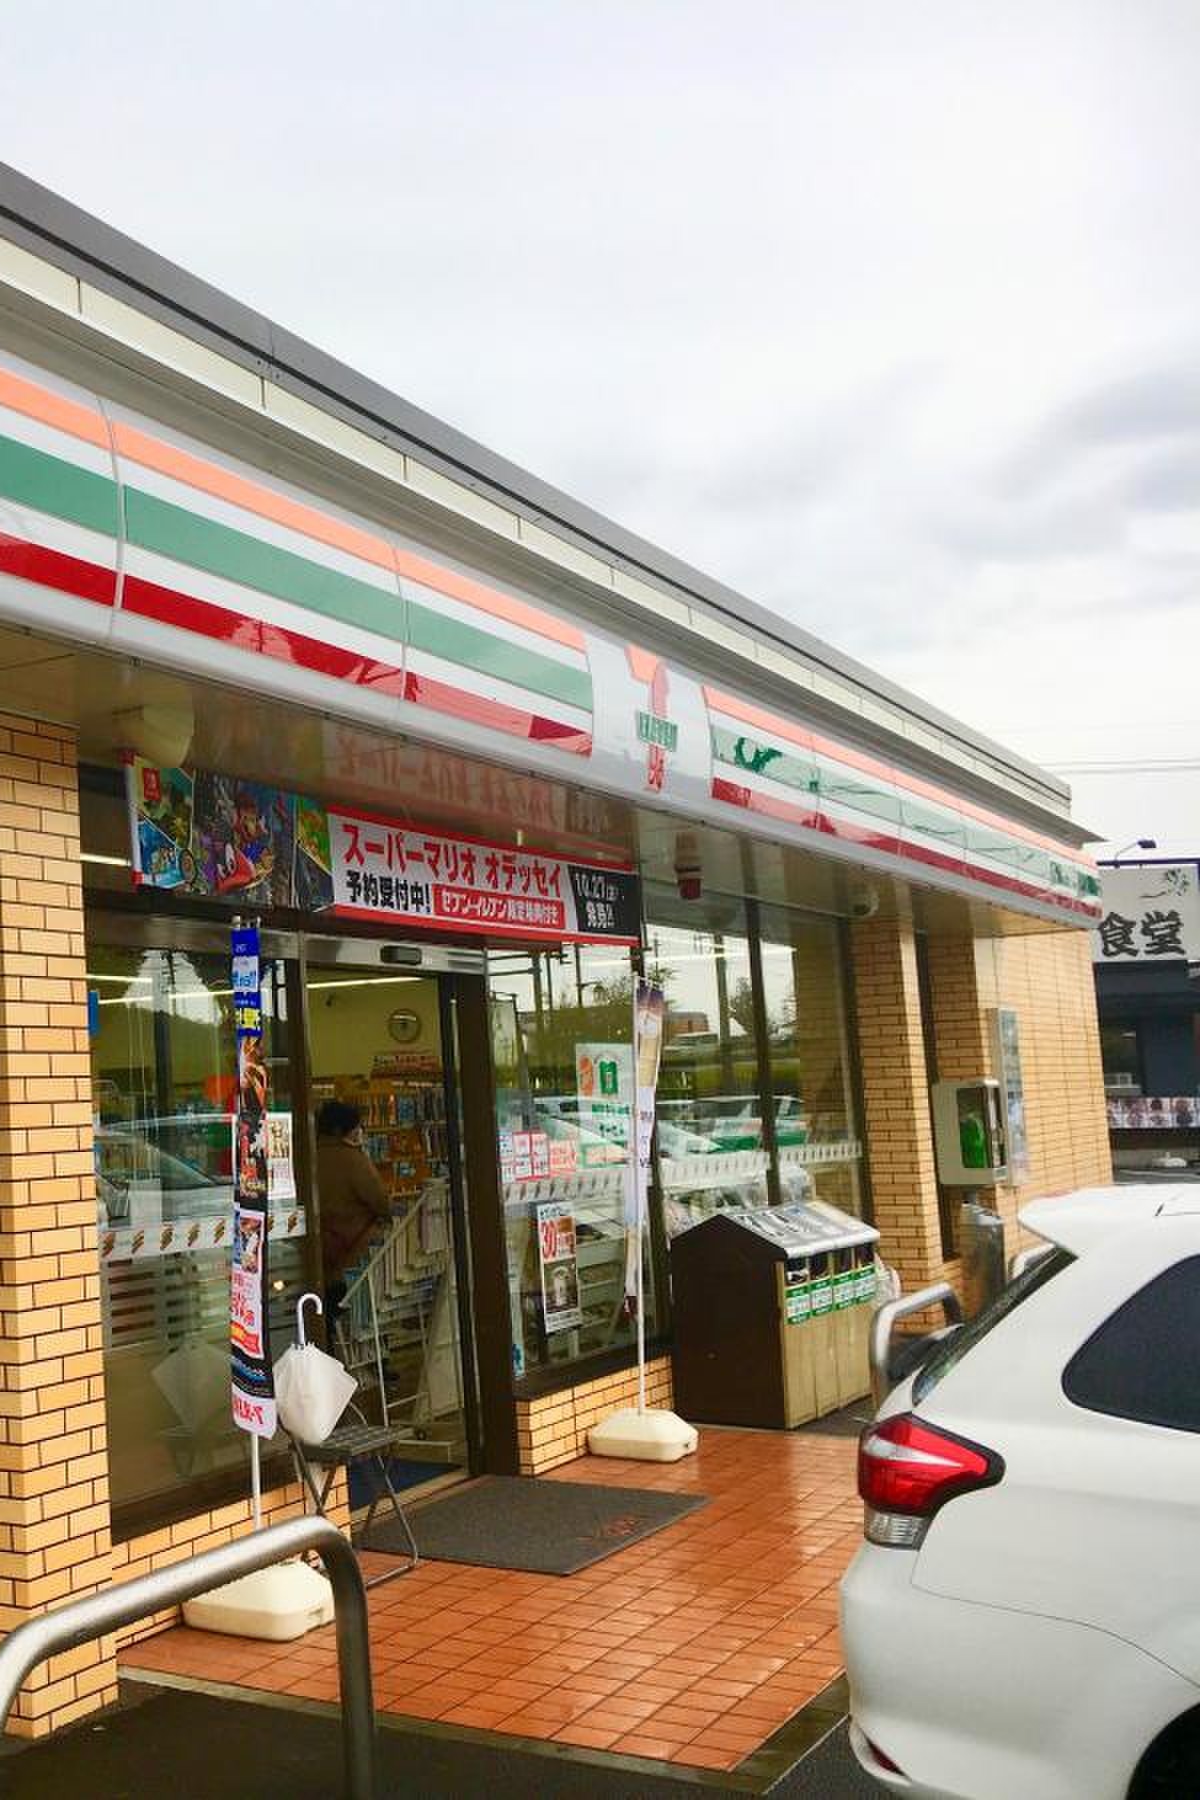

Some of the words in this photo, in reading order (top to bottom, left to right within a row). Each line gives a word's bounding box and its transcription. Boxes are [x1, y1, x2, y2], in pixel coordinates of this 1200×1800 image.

[342, 823, 476, 885] スーパーマリオ
[485, 852, 562, 898] オデッセイ
[1098, 911, 1187, 957] 食堂
